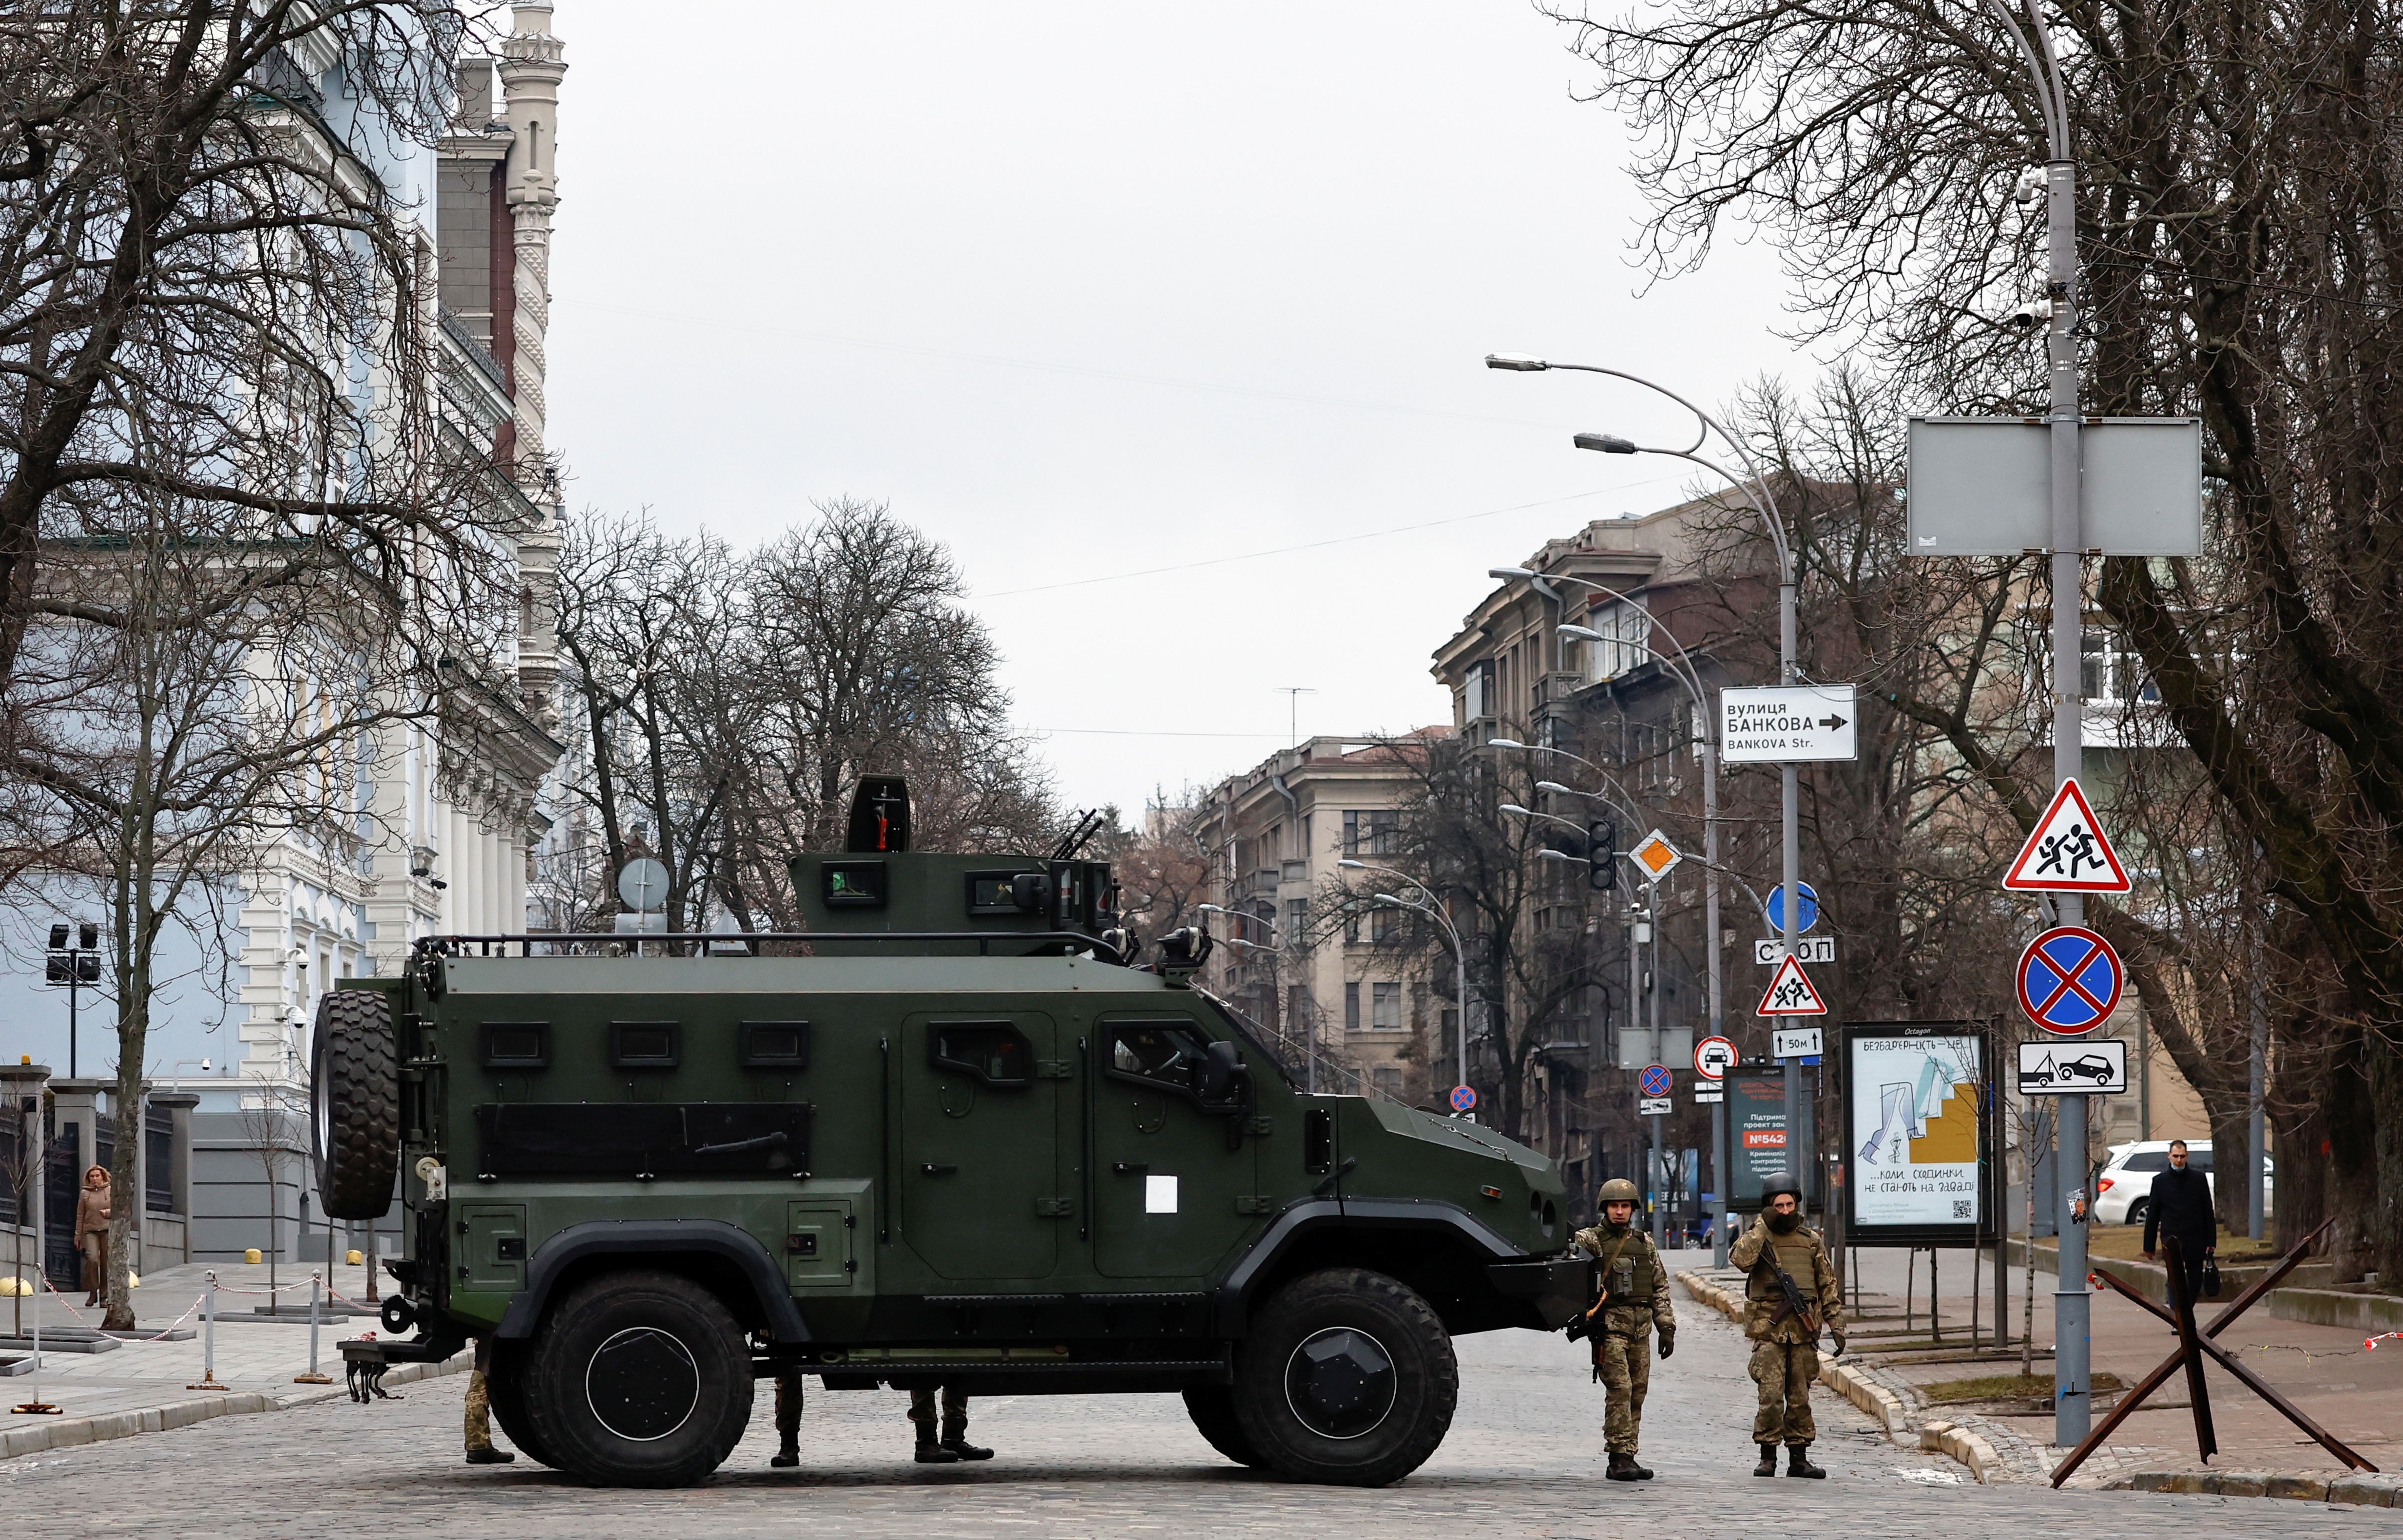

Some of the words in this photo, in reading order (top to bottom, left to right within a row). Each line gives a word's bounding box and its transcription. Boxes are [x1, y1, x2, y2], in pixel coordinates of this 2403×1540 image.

[1729, 717, 1814, 732] БАНКОВА
[1729, 739, 1786, 749] BANKOVA
[1792, 738, 1813, 748] Str.
[1759, 941, 1831, 961] СОП
